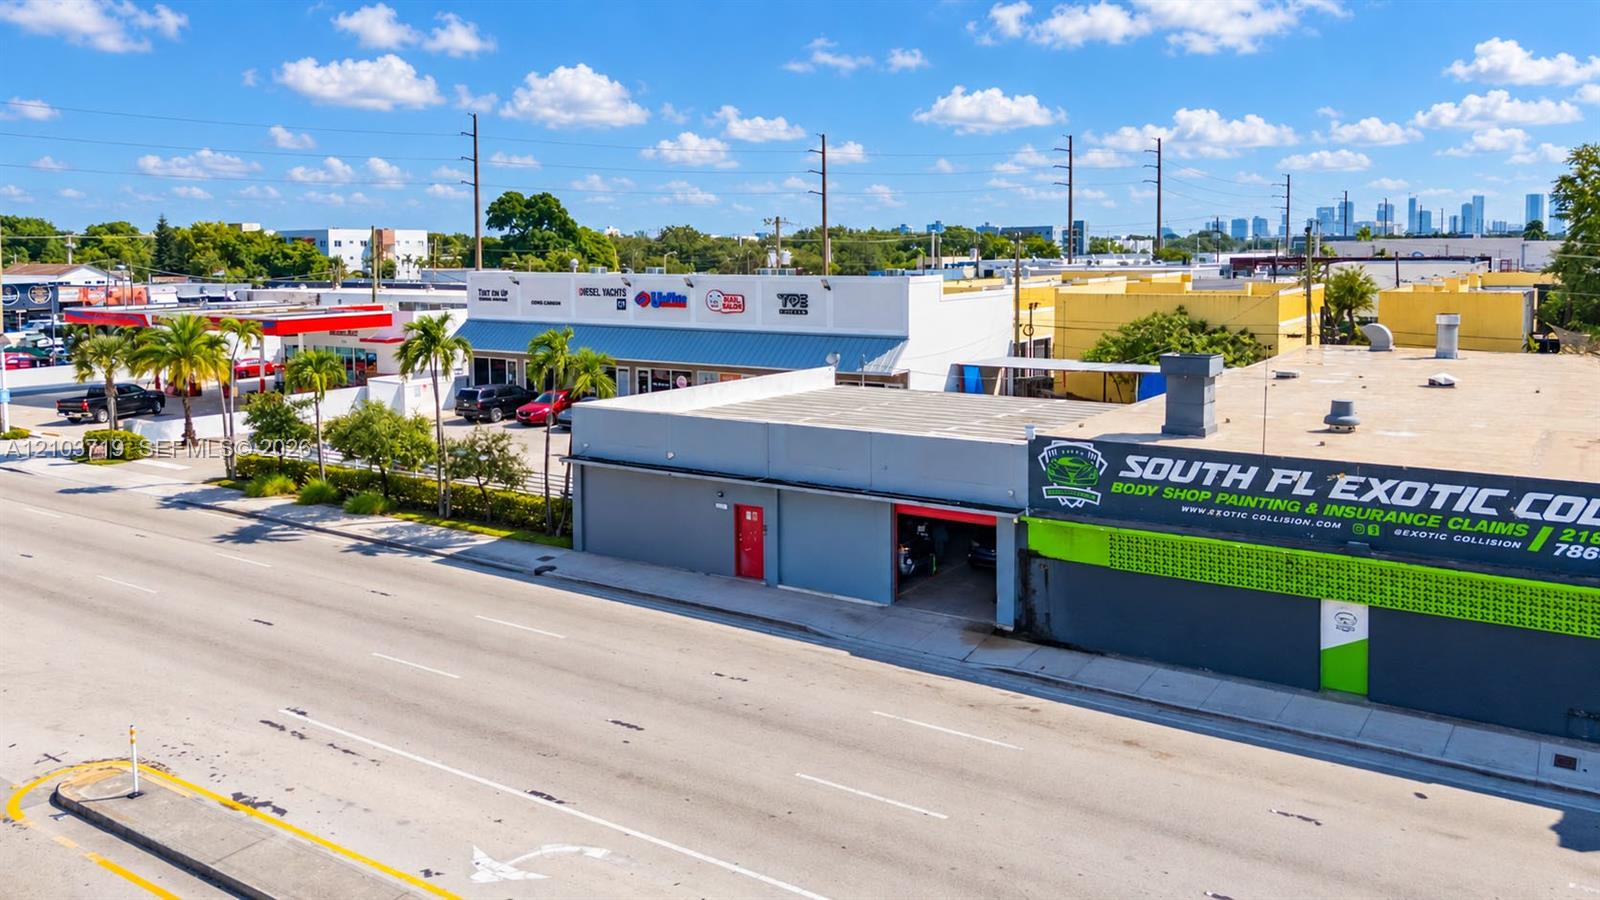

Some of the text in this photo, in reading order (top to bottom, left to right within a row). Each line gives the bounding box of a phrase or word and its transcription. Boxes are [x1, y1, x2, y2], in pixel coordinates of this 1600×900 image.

[579, 288, 627, 297] DIESEL YACHTS
[1118, 454, 1260, 490] SOUTH
[1265, 468, 1317, 496] FL
[1328, 474, 1510, 516] EXOTIC
[1111, 481, 1160, 498] BODY
[1162, 486, 1213, 504] SHOP
[1215, 492, 1301, 514] PAINTING
[1305, 501, 1319, 515] &
[1322, 502, 1444, 528] INSURANCE
[1447, 517, 1530, 537] CLAIMS
[1251, 513, 1342, 529] COLLISION.COM
[1394, 528, 1522, 549] @EXOTIC COLLISION
[1553, 543, 1600, 560] 786
